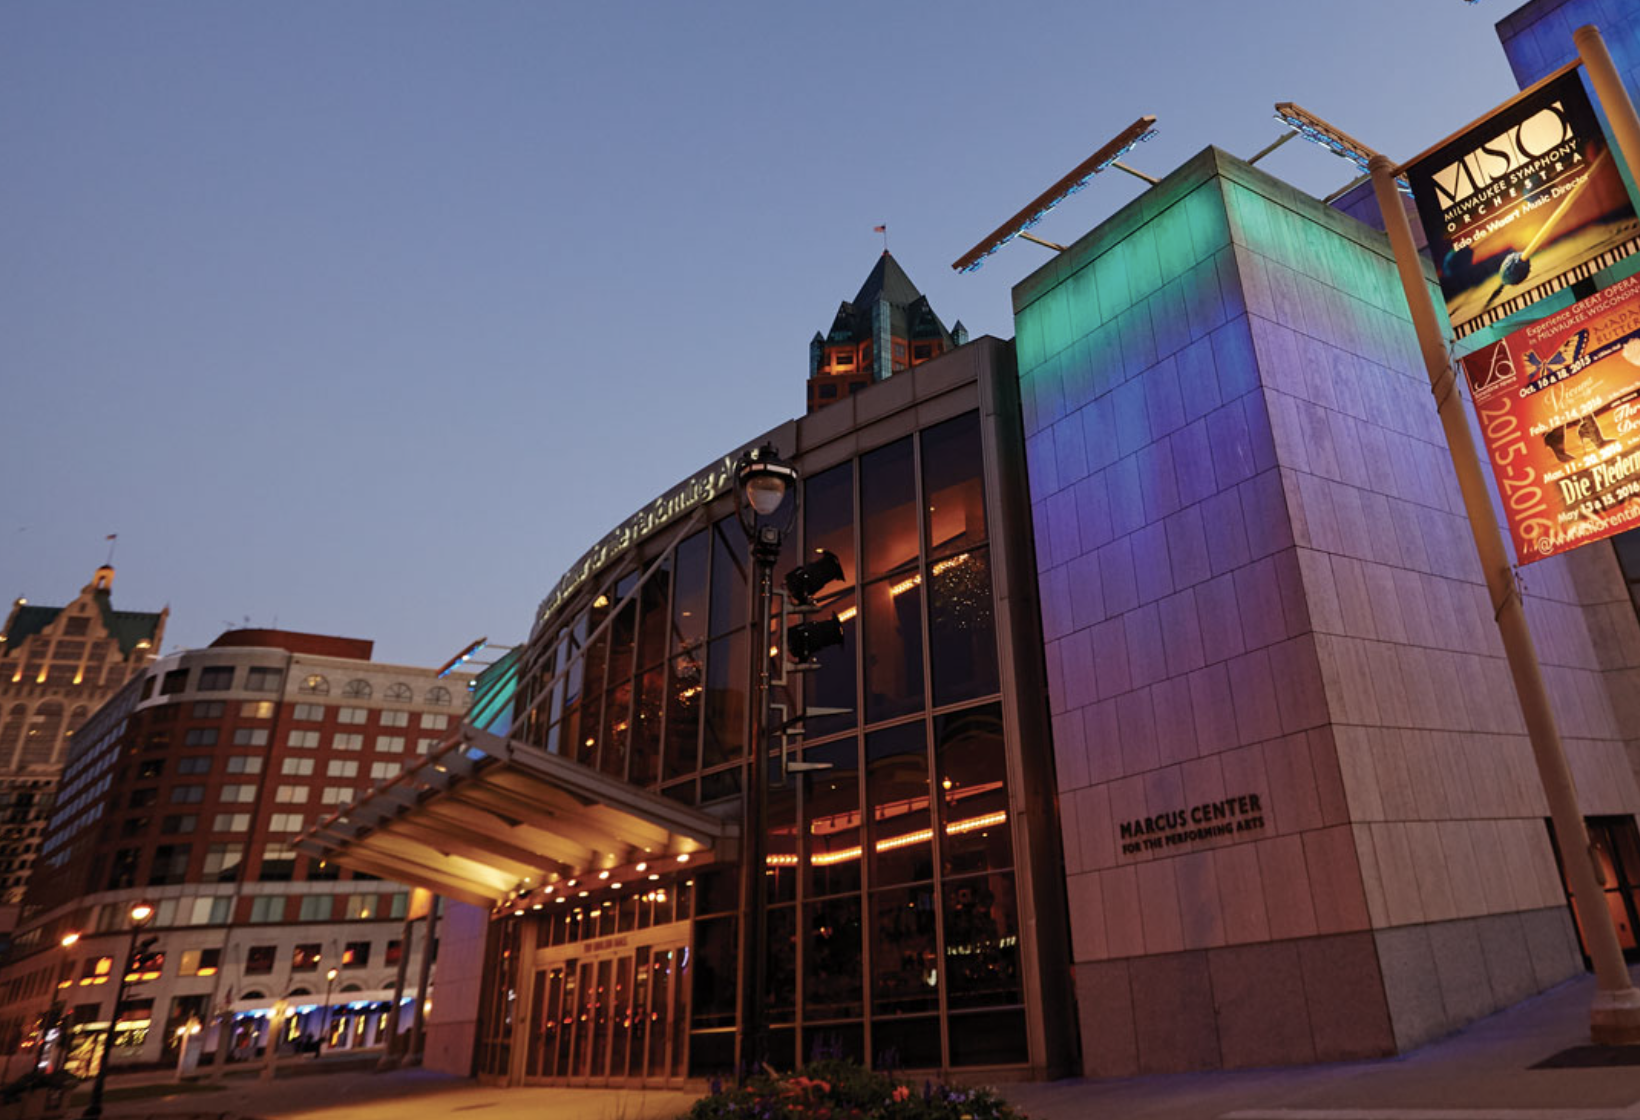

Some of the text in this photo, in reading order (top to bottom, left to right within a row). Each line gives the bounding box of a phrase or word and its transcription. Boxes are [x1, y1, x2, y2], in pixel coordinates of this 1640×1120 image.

[1444, 140, 1577, 221] MILWAUKEE SYMPHONY
[1447, 152, 1583, 232] ORCHESTRA
[1522, 194, 1550, 215] Music
[1551, 173, 1588, 199] Director
[1526, 276, 1638, 337] Experience GREAT OPERA
[1519, 384, 1537, 398] Oct.
[1570, 355, 1592, 374] 2015
[1481, 398, 1554, 539] 2015-2016
[1559, 475, 1592, 506] Die
[1557, 509, 1580, 523] May
[1120, 793, 1263, 840] MARCUS CENTER
[1122, 815, 1265, 855] FOR THE PERFORMING ARTS
